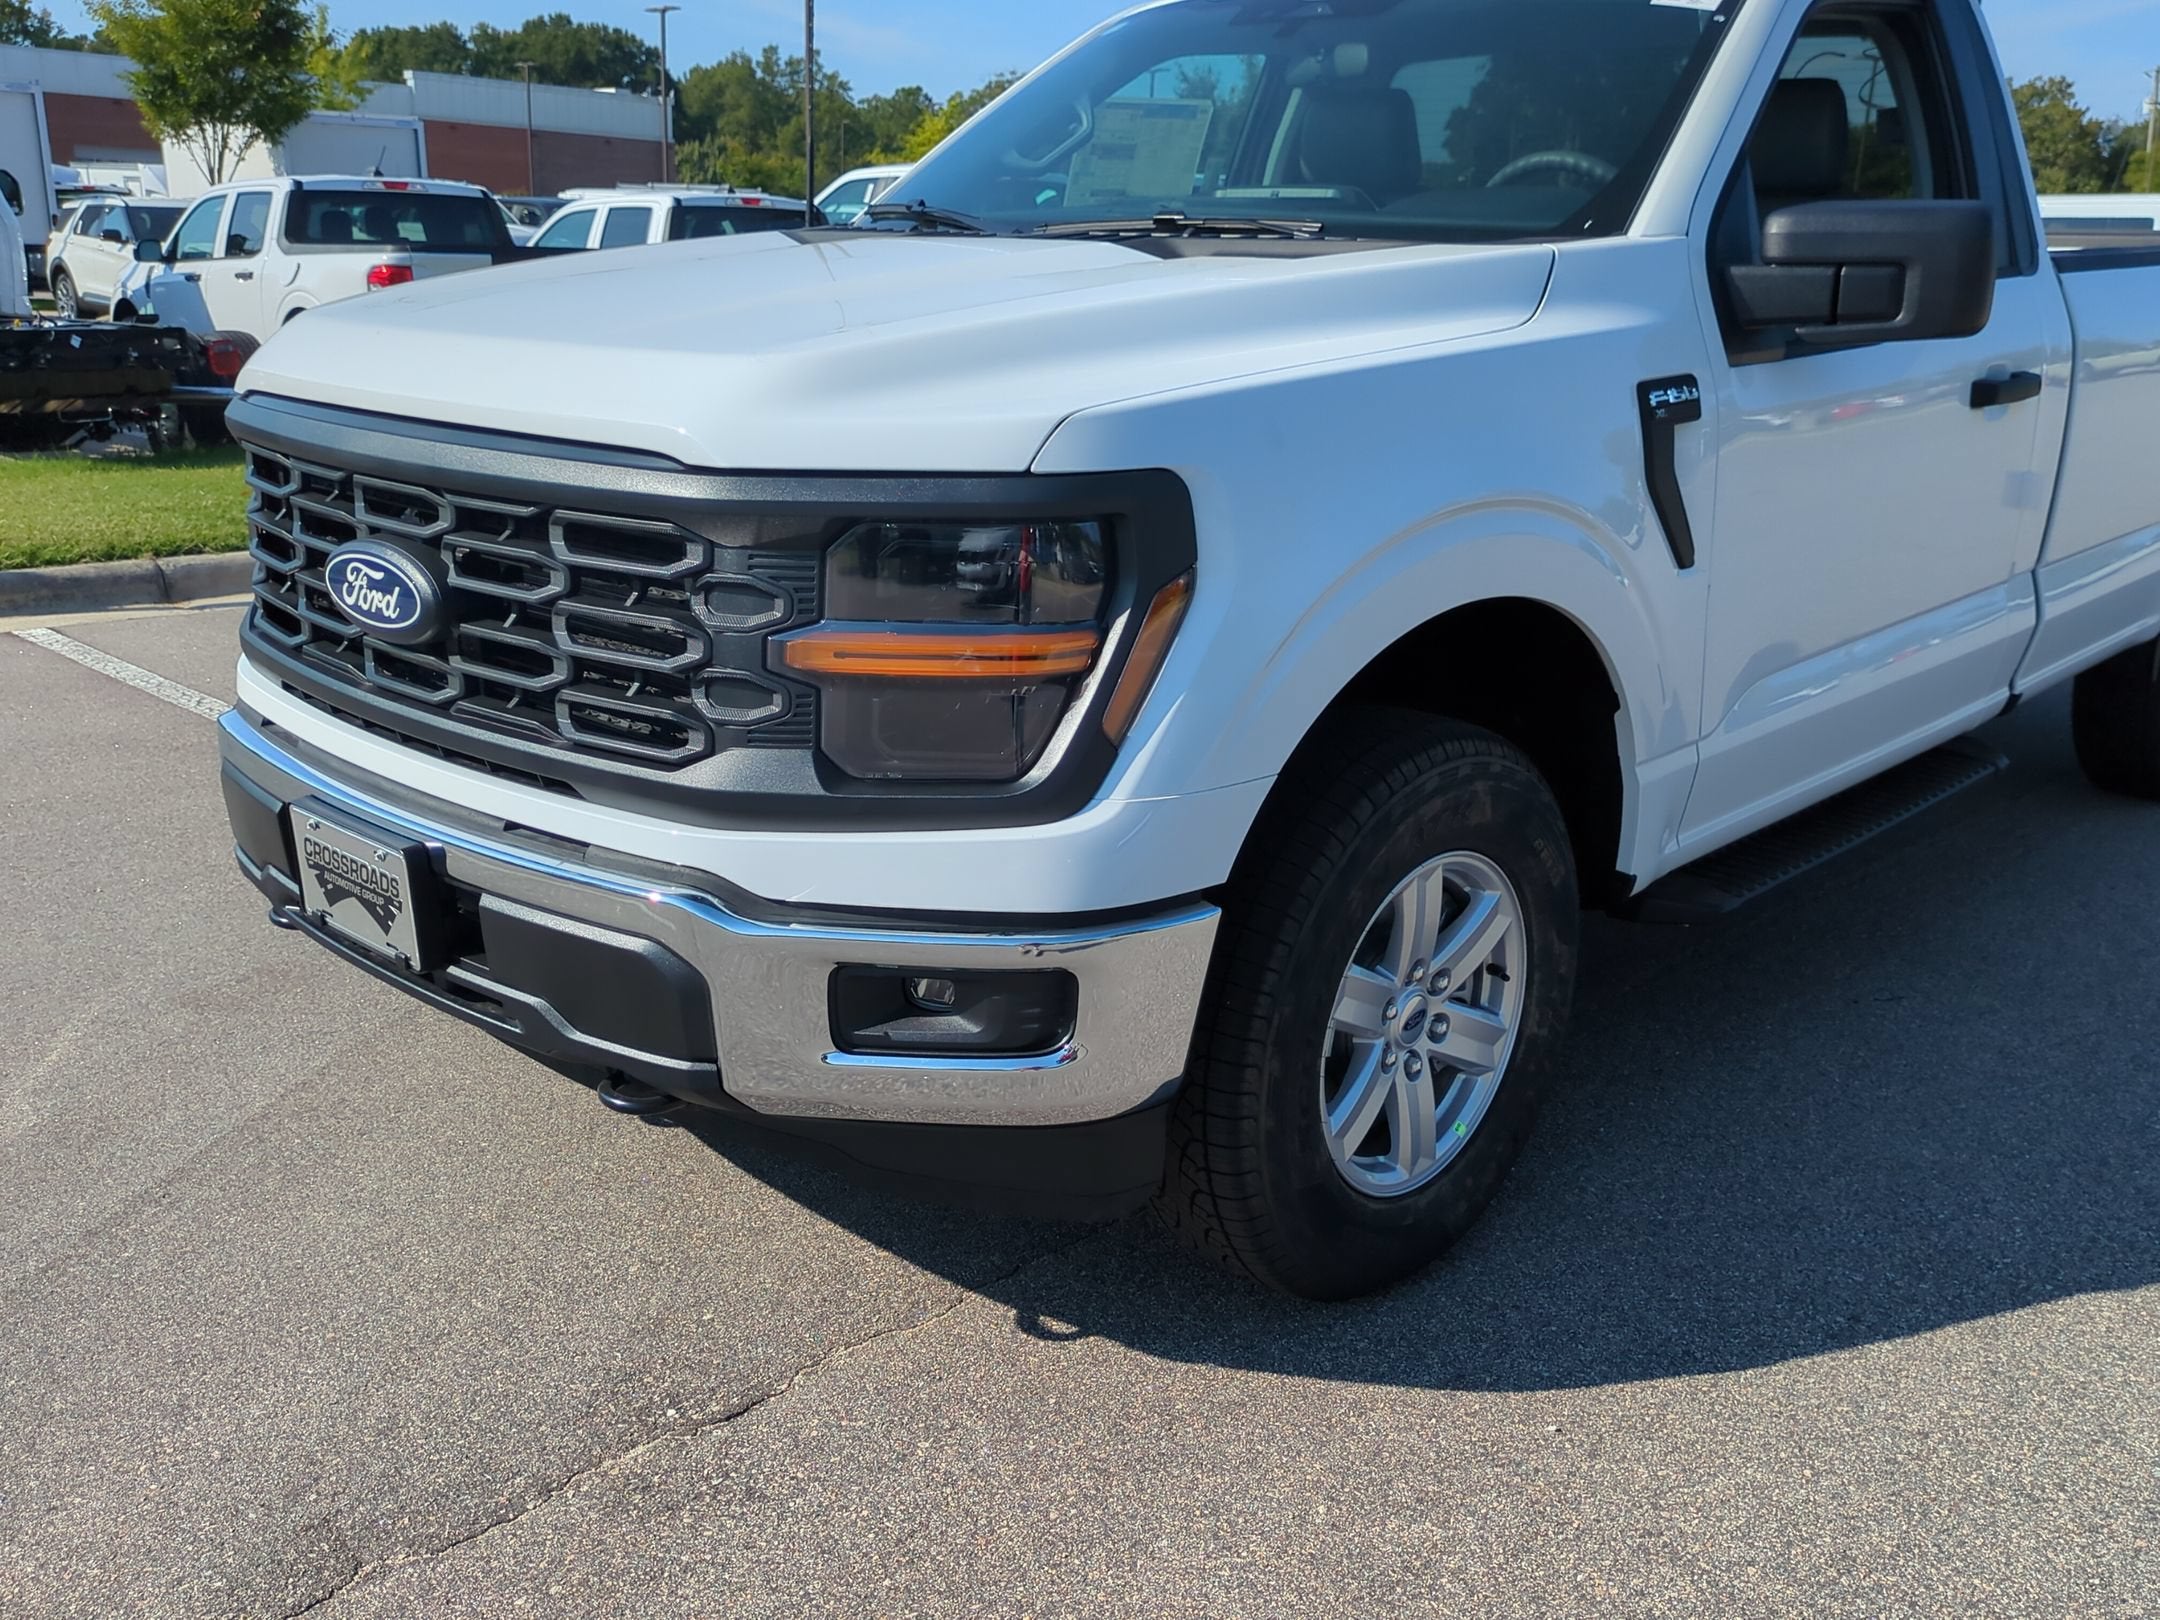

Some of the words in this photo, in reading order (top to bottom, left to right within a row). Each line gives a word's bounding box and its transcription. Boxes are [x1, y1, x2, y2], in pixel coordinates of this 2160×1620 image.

[343, 562, 400, 619] Ford
[303, 836, 400, 899] CROSSROADS
[324, 870, 362, 896] AUTOMOTIVE
[361, 888, 385, 906] GROUP
